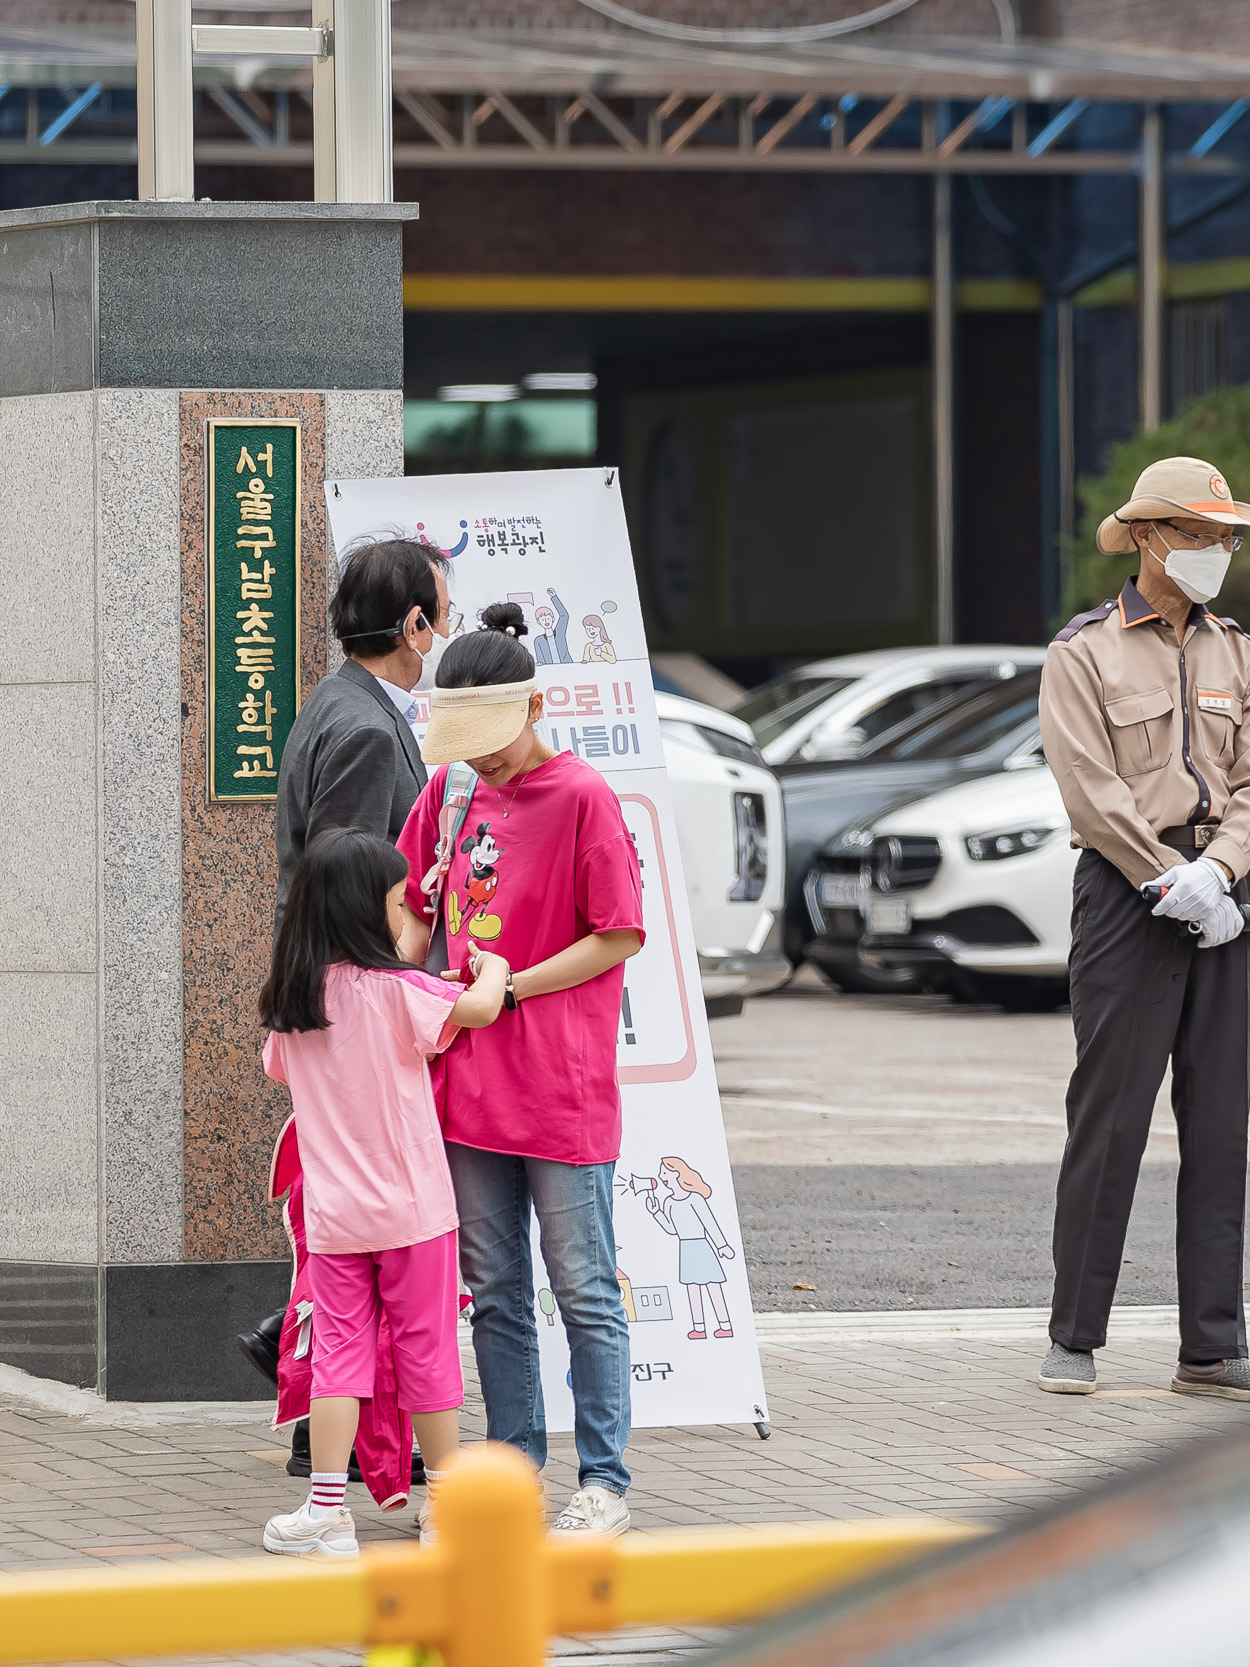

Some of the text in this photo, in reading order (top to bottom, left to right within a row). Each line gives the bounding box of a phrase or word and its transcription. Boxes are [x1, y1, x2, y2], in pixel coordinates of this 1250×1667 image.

[507, 515, 542, 532] 발전하는
[476, 530, 546, 557] 행복광진
[233, 443, 278, 779] 서울구남초등학교
[541, 684, 604, 719] 으로
[630, 1362, 674, 1381] 진구
